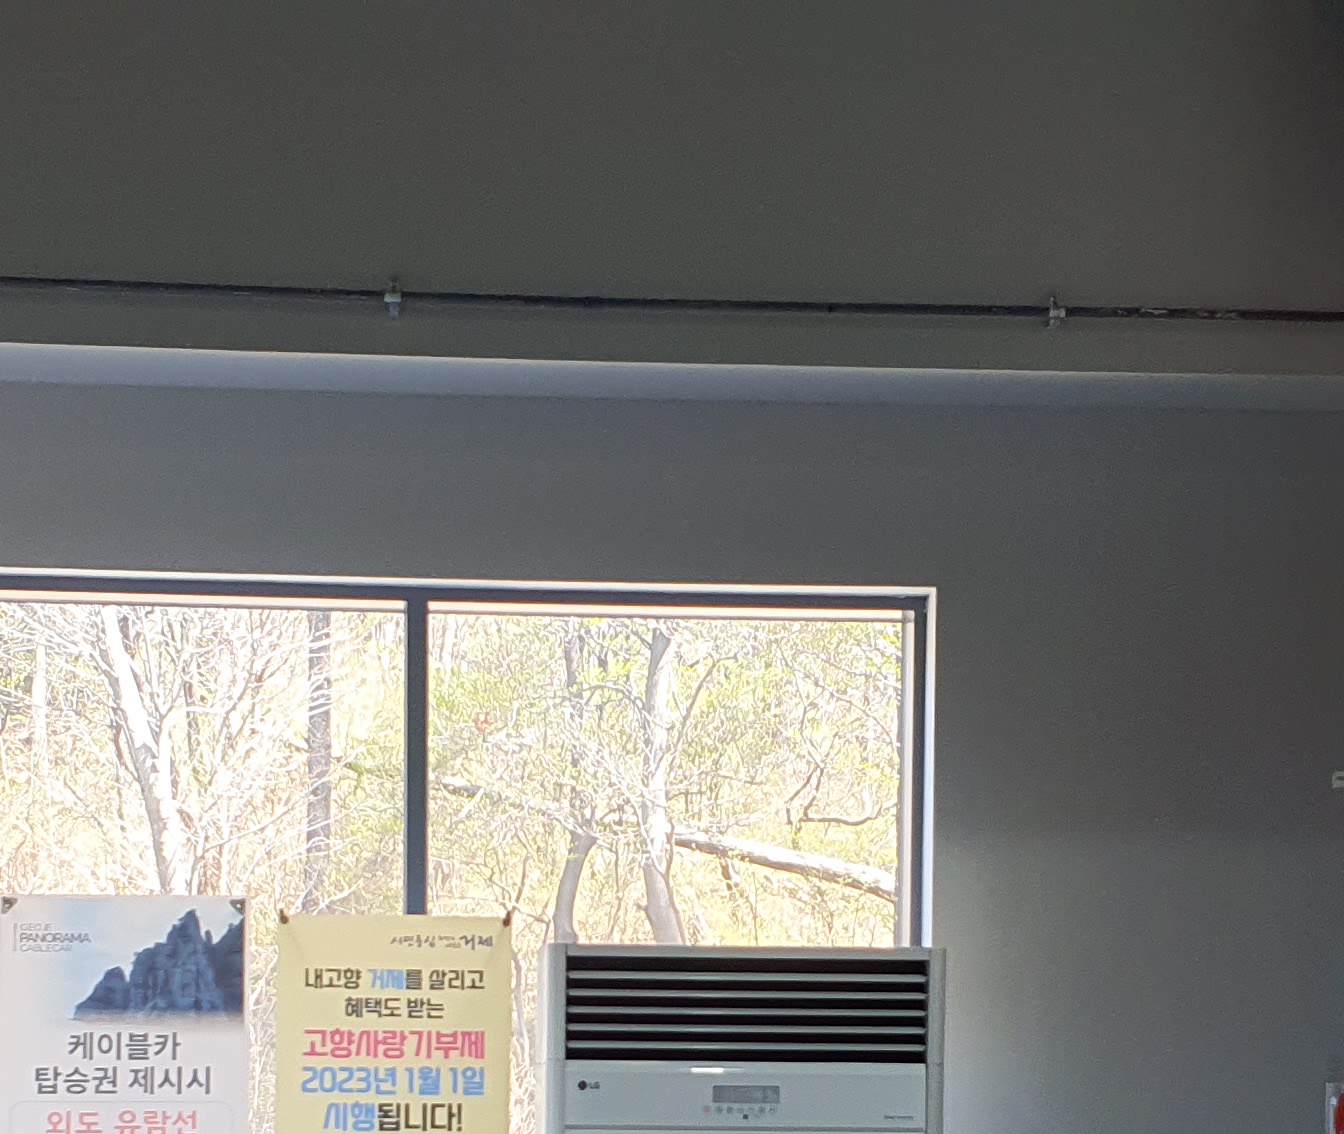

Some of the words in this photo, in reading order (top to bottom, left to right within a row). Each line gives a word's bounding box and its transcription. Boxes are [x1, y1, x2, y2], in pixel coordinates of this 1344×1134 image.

[19, 931, 92, 944] PANORAMA
[304, 967, 362, 991] 내고향
[367, 968, 424, 991] 거제를
[428, 968, 486, 991] 살리고
[344, 995, 403, 1019] 혜택도
[406, 995, 446, 1019] 받는
[67, 1031, 182, 1061] 케이블카
[302, 1027, 486, 1060] 고향사랑기부제
[34, 1065, 119, 1095] 탑승권
[128, 1065, 213, 1095] 제시시
[300, 1065, 398, 1095] 2023년
[404, 1065, 442, 1095] 1월
[448, 1065, 486, 1096] 1일
[323, 1101, 463, 1133] 시행됩니다!
